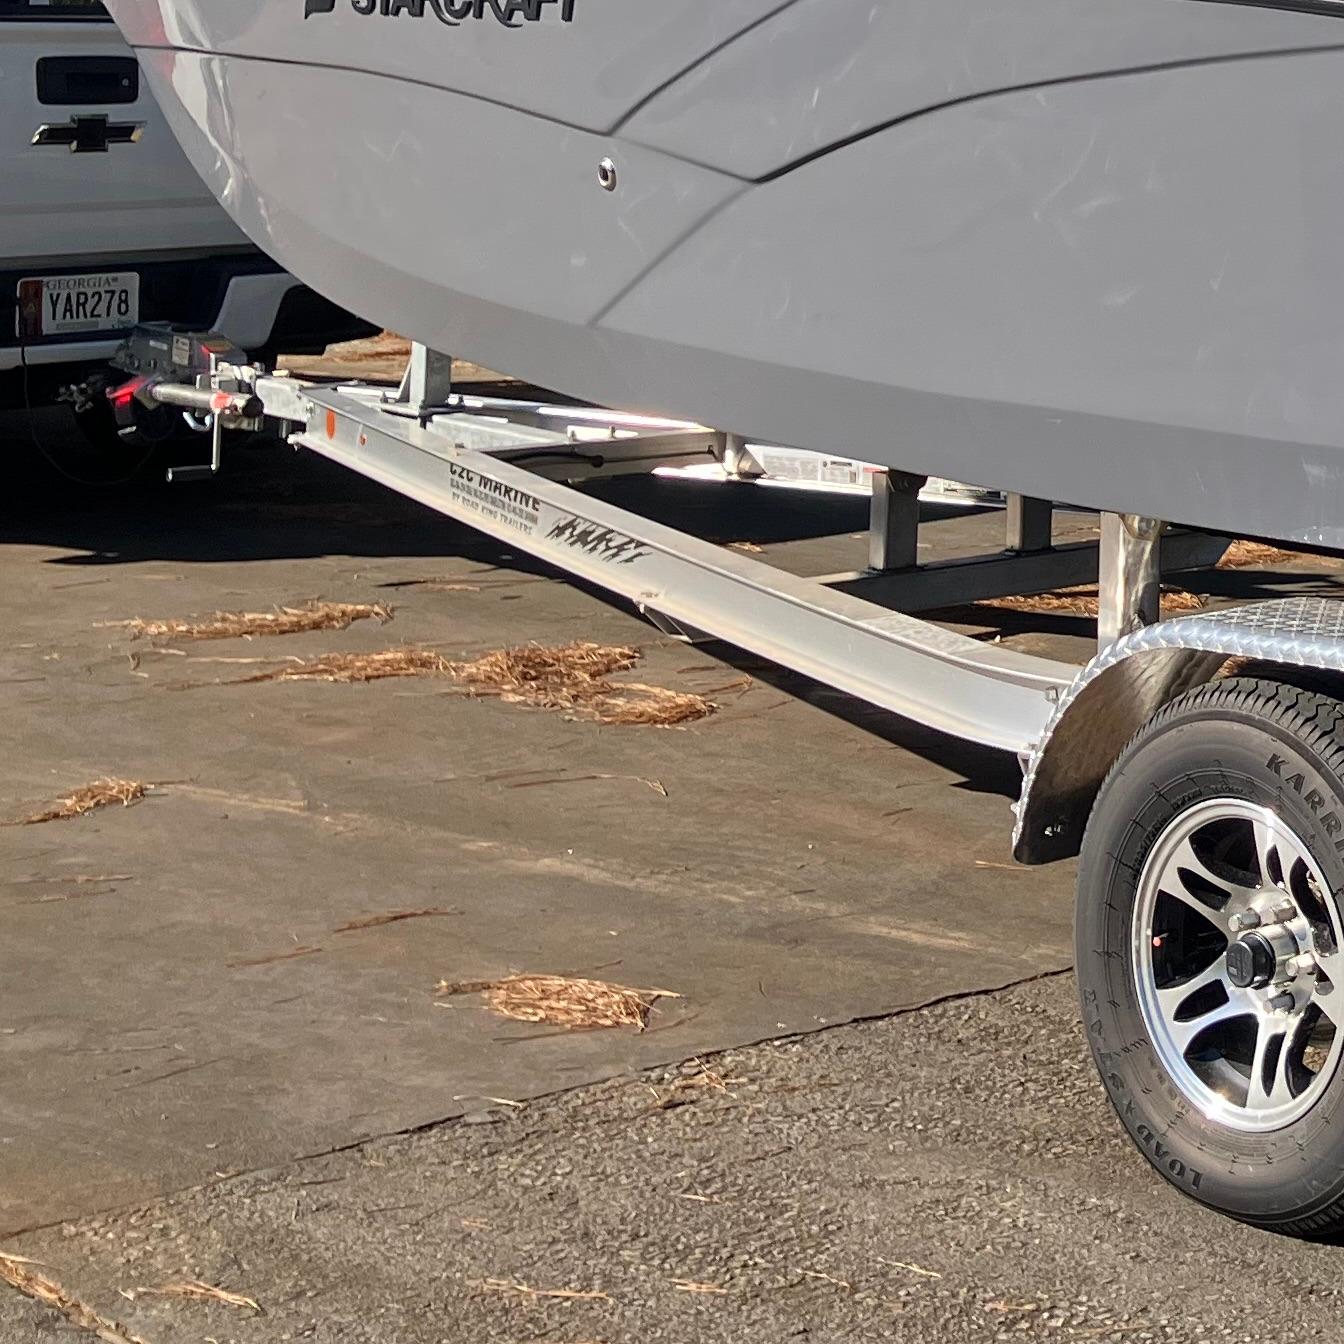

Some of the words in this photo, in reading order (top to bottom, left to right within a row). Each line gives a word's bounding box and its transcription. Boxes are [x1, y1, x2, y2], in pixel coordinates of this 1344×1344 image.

[46, 276, 112, 291] GEORGIA
[49, 289, 130, 320] YAR278
[1136, 1123, 1204, 1189] LOAD
